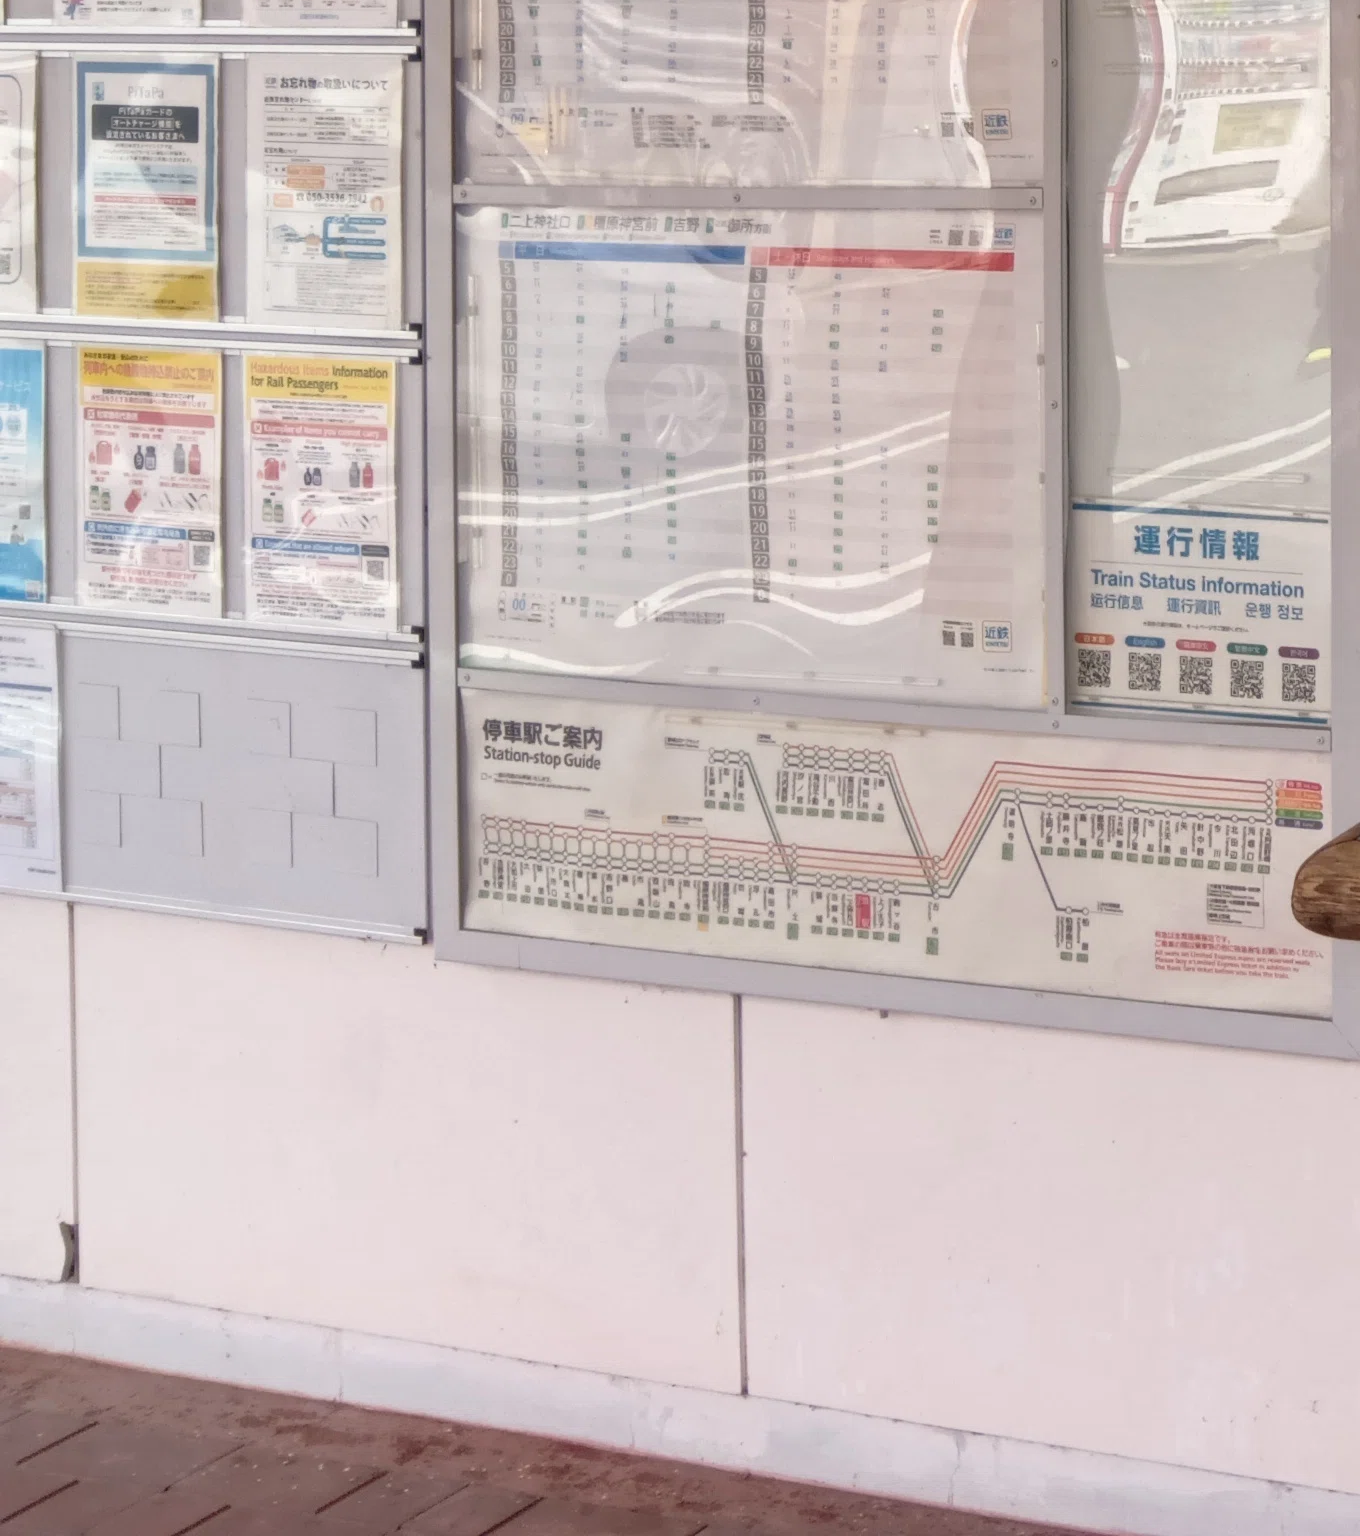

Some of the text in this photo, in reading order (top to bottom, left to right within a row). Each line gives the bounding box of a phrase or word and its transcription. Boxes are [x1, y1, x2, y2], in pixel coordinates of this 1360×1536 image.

[251, 377, 339, 392] for Rail Passengers
[332, 365, 388, 380] Information
[1134, 525, 1259, 561] 運行情報
[1091, 569, 1304, 598] Train Status Information
[1091, 593, 1304, 621] 运行信息 運行資訊 운행 정보
[483, 718, 602, 750] 停車駅ご案内
[484, 746, 600, 769] Station-stop Guide
